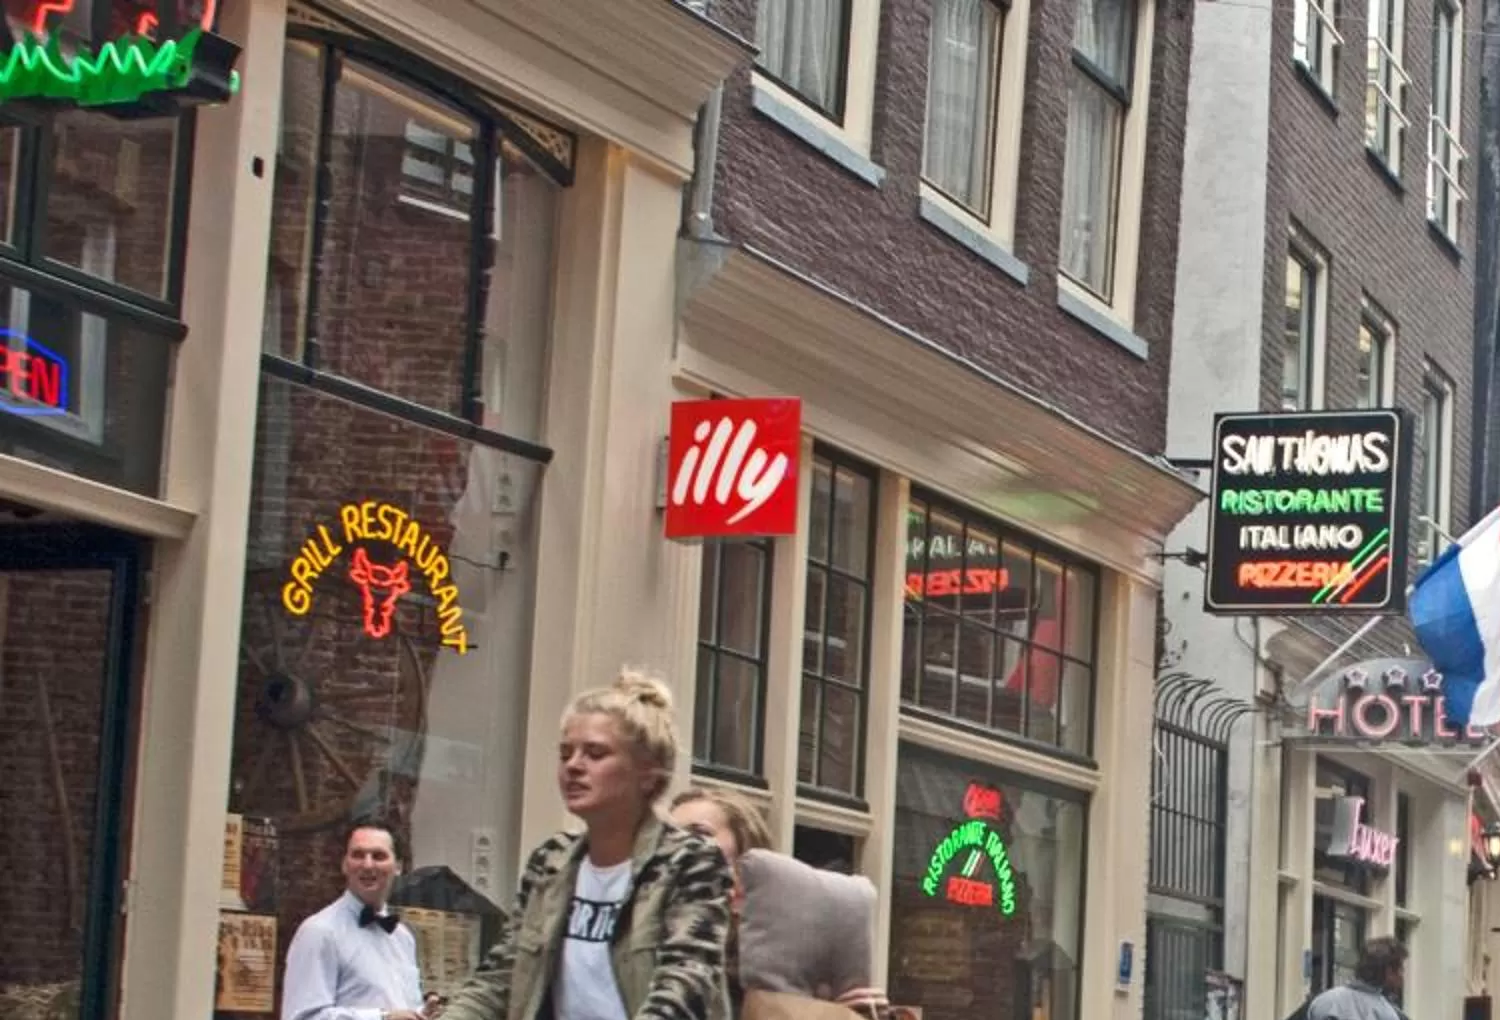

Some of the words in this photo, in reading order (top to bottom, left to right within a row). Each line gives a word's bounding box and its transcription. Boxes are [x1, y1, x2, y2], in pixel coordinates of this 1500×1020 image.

[672, 416, 788, 525] illy
[1220, 488, 1384, 514] RISTORANTE
[1239, 524, 1364, 549] ITALIANO
[283, 525, 342, 616] GRILL
[341, 502, 467, 655] RESTAURANT
[1237, 561, 1353, 588] PIZZERIA
[923, 821, 987, 896] RISTORANTE
